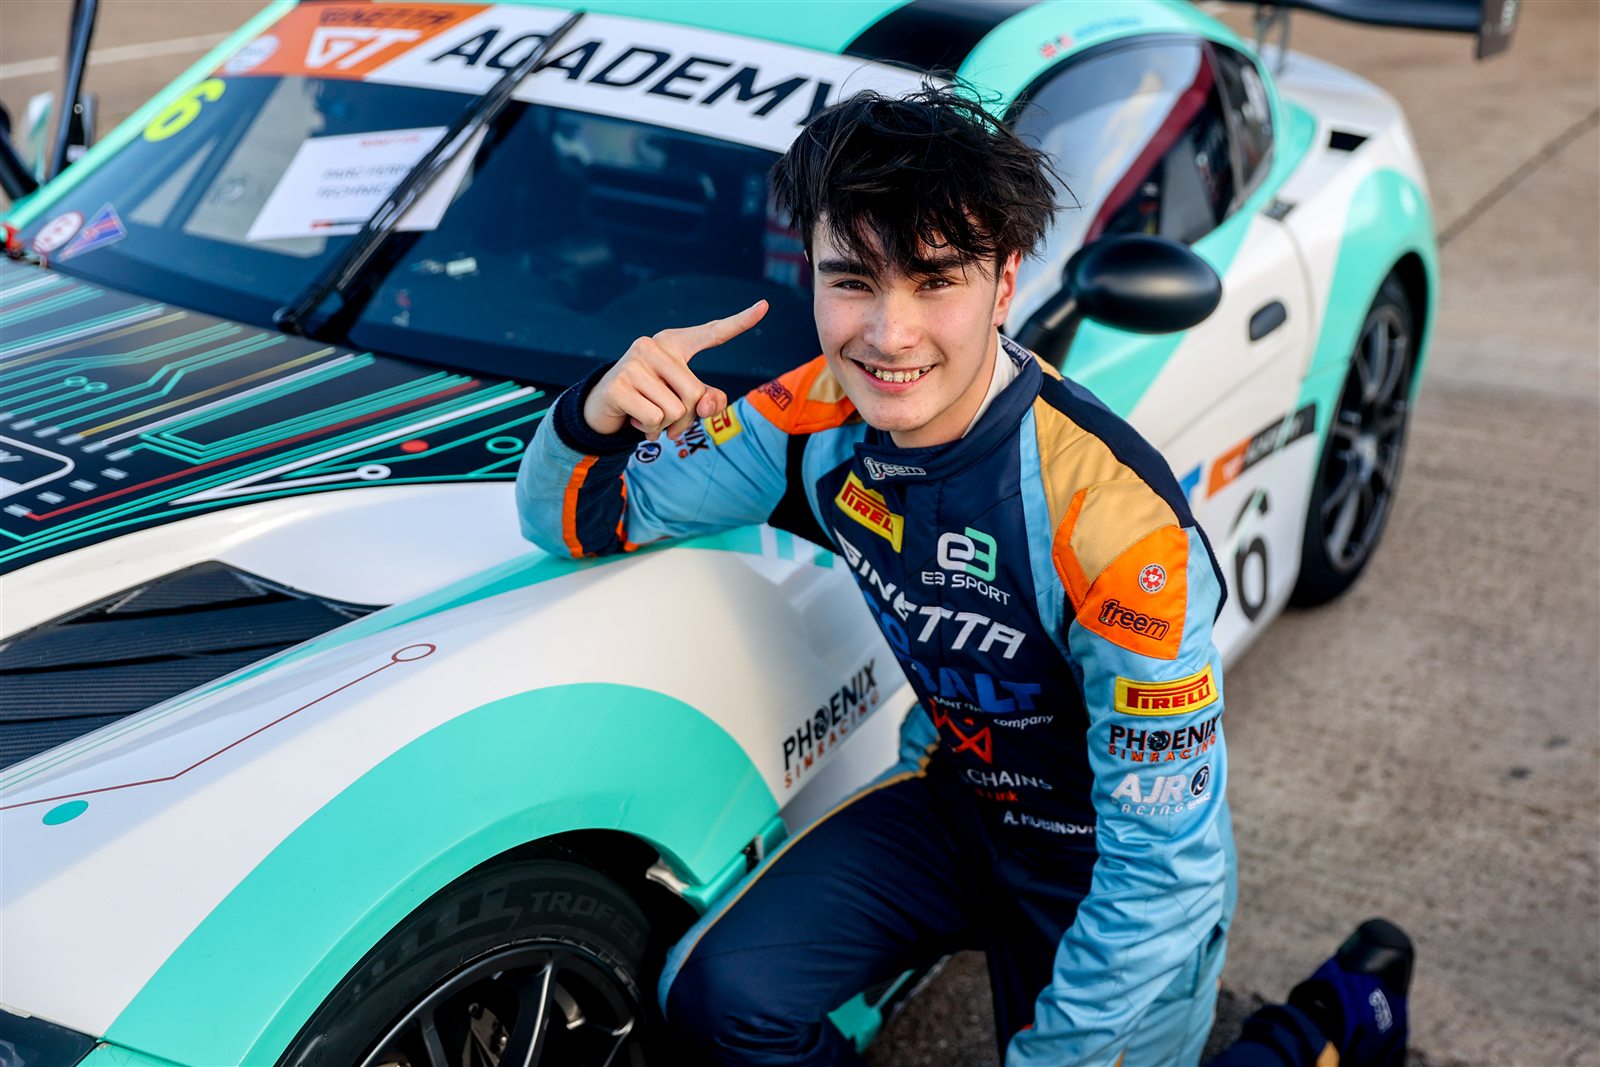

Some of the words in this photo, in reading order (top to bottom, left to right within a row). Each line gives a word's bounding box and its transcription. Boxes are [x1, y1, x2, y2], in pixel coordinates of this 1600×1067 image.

[304, 26, 422, 70] GT
[863, 456, 927, 480] freem
[840, 480, 895, 533] PIREL
[951, 573, 1011, 606] SPORT
[1098, 599, 1170, 640] freem
[1126, 673, 1211, 710] PIRELLI
[781, 658, 878, 771] PHOENIX
[993, 715, 1054, 730] company
[1110, 714, 1222, 752] PHOENIX
[784, 688, 880, 789] SIMRACING
[1108, 735, 1217, 764] SIMRACING
[1110, 772, 1187, 804] AJR
[1111, 800, 1185, 816] ACING
